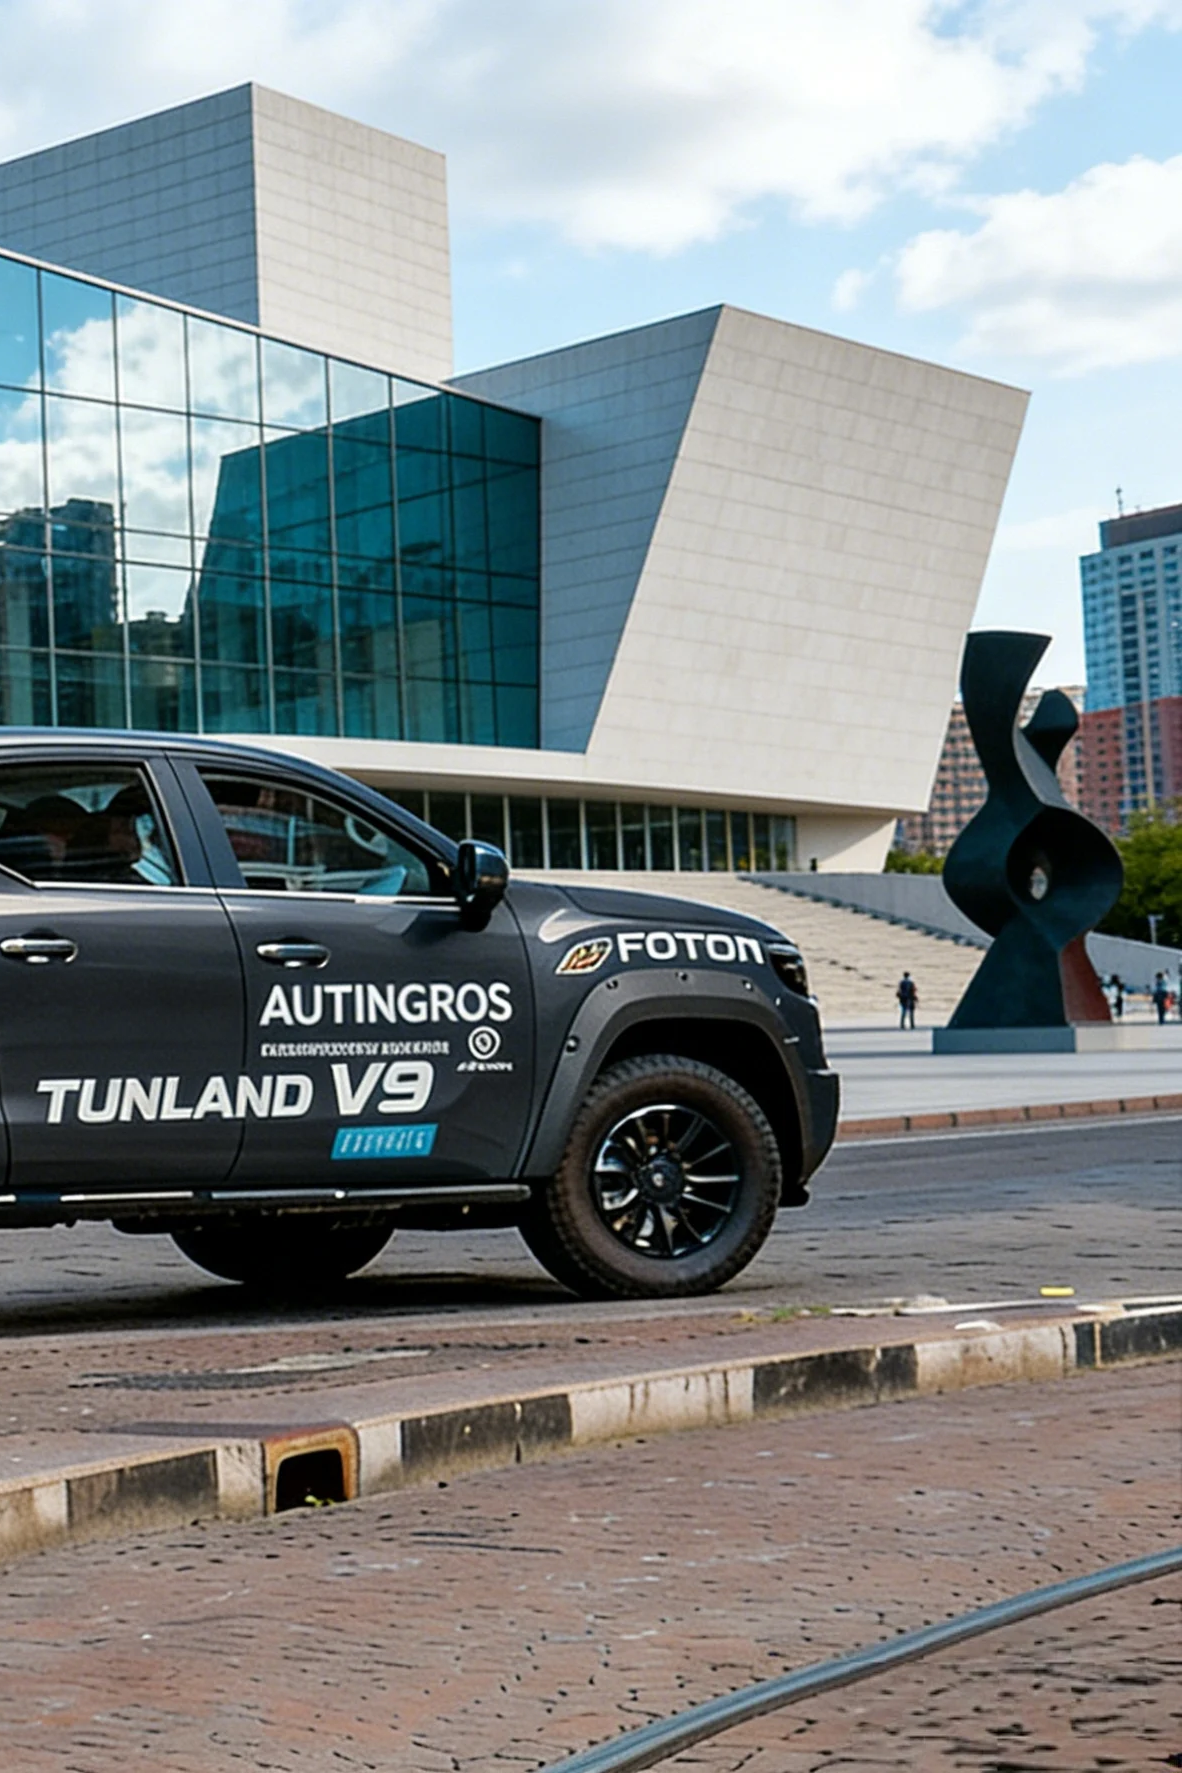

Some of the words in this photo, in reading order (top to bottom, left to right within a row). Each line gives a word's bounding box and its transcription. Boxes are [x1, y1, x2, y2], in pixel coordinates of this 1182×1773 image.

[616, 931, 765, 965] FOTON
[259, 982, 513, 1027] AUTINGROS
[37, 1074, 314, 1124] TUNLAND
[330, 1060, 435, 1116] V9
